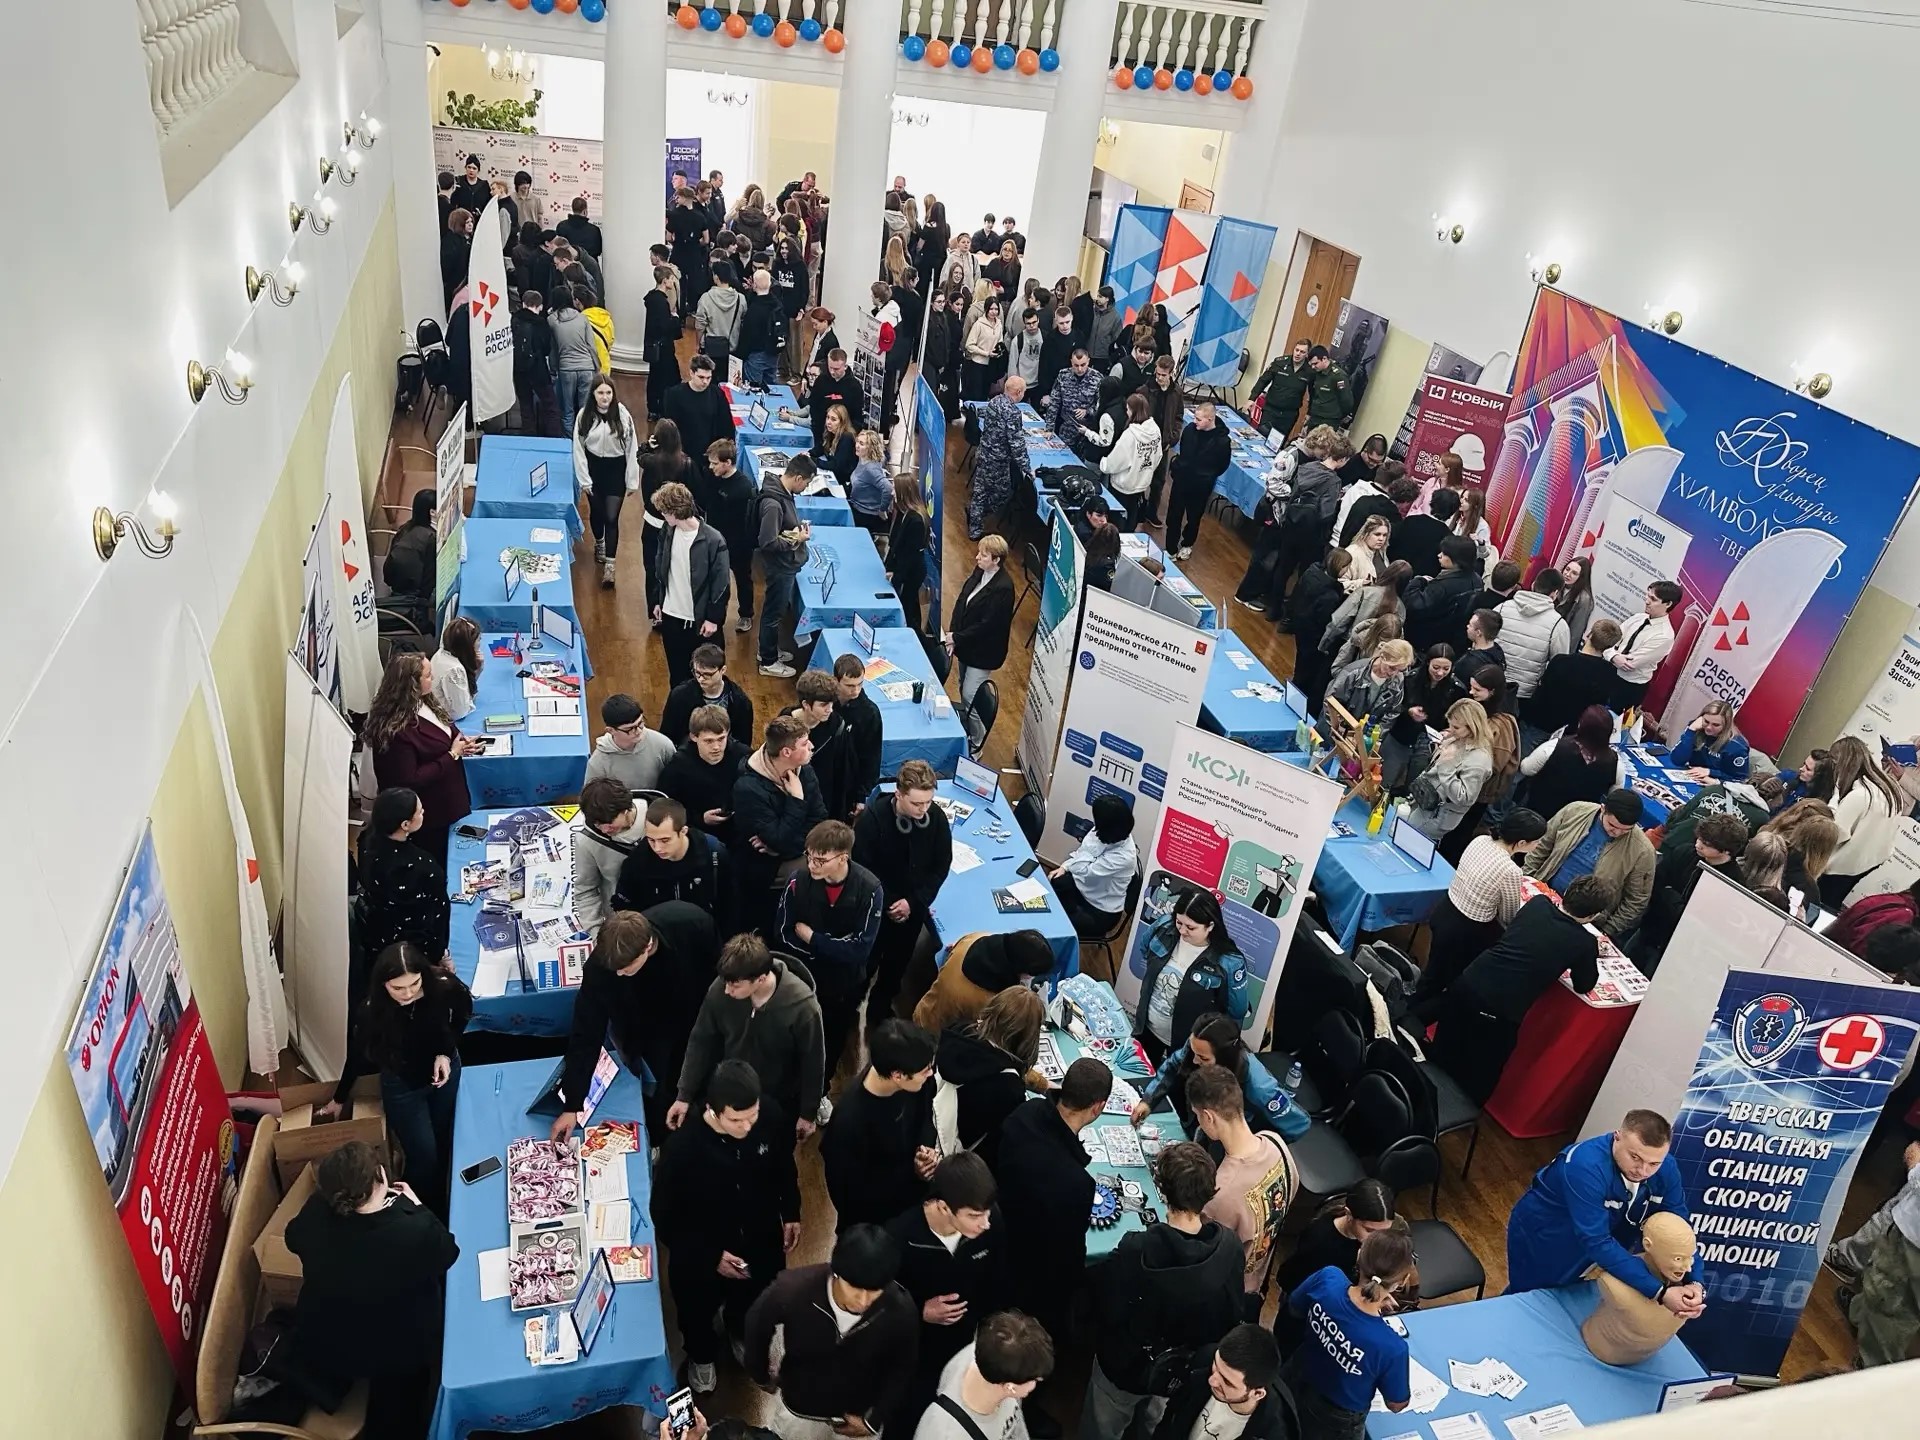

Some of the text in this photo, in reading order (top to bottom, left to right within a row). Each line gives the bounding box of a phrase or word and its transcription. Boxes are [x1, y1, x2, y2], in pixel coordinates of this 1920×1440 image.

[671, 154, 699, 162] ОБЛАСТИ
[1450, 389, 1505, 411] НОВЫЙ
[1639, 523, 1666, 544] ГАЗПРОМ
[1084, 632, 1139, 661] предприятие
[1086, 622, 1131, 645] социально
[1131, 641, 1197, 674] ответственное
[1088, 610, 1160, 646] Верхневолжское
[1161, 641, 1180, 655] АТП
[1693, 669, 1742, 711] РОССИИ
[1701, 657, 1747, 700] РАБОТА
[1177, 791, 1207, 807] России!
[1179, 785, 1299, 839] машиностроительного холдинга
[1181, 777, 1203, 790] Стань
[1203, 786, 1230, 801] частью
[1230, 797, 1267, 817] ведущего
[90, 962, 120, 1046] ORION
[149, 1052, 182, 1176] СТАБИЛЬНАЯ КОМПАНИЯ
[193, 1102, 202, 1137] РОСТА
[1727, 1100, 1834, 1131] ТВЕРСКАЯ
[1703, 1128, 1833, 1161] ОБЛАСТНАЯ
[159, 1139, 177, 1206] ДОСТОЙНАЯ
[165, 1135, 184, 1208] СОЦИАЛЬНЫЕ
[1707, 1158, 1808, 1187] СТАНЦИЯ
[175, 1181, 189, 1237] РАЗВИТИЯ
[1703, 1186, 1793, 1213] СКОРОЙ
[1689, 1212, 1822, 1245] ДИЦИНСКОЙ
[1698, 1242, 1781, 1269] ОМОЩИ
[1307, 1308, 1362, 1376] ПОМОЩЬ
[1313, 1303, 1365, 1362] СКОРАЯ
